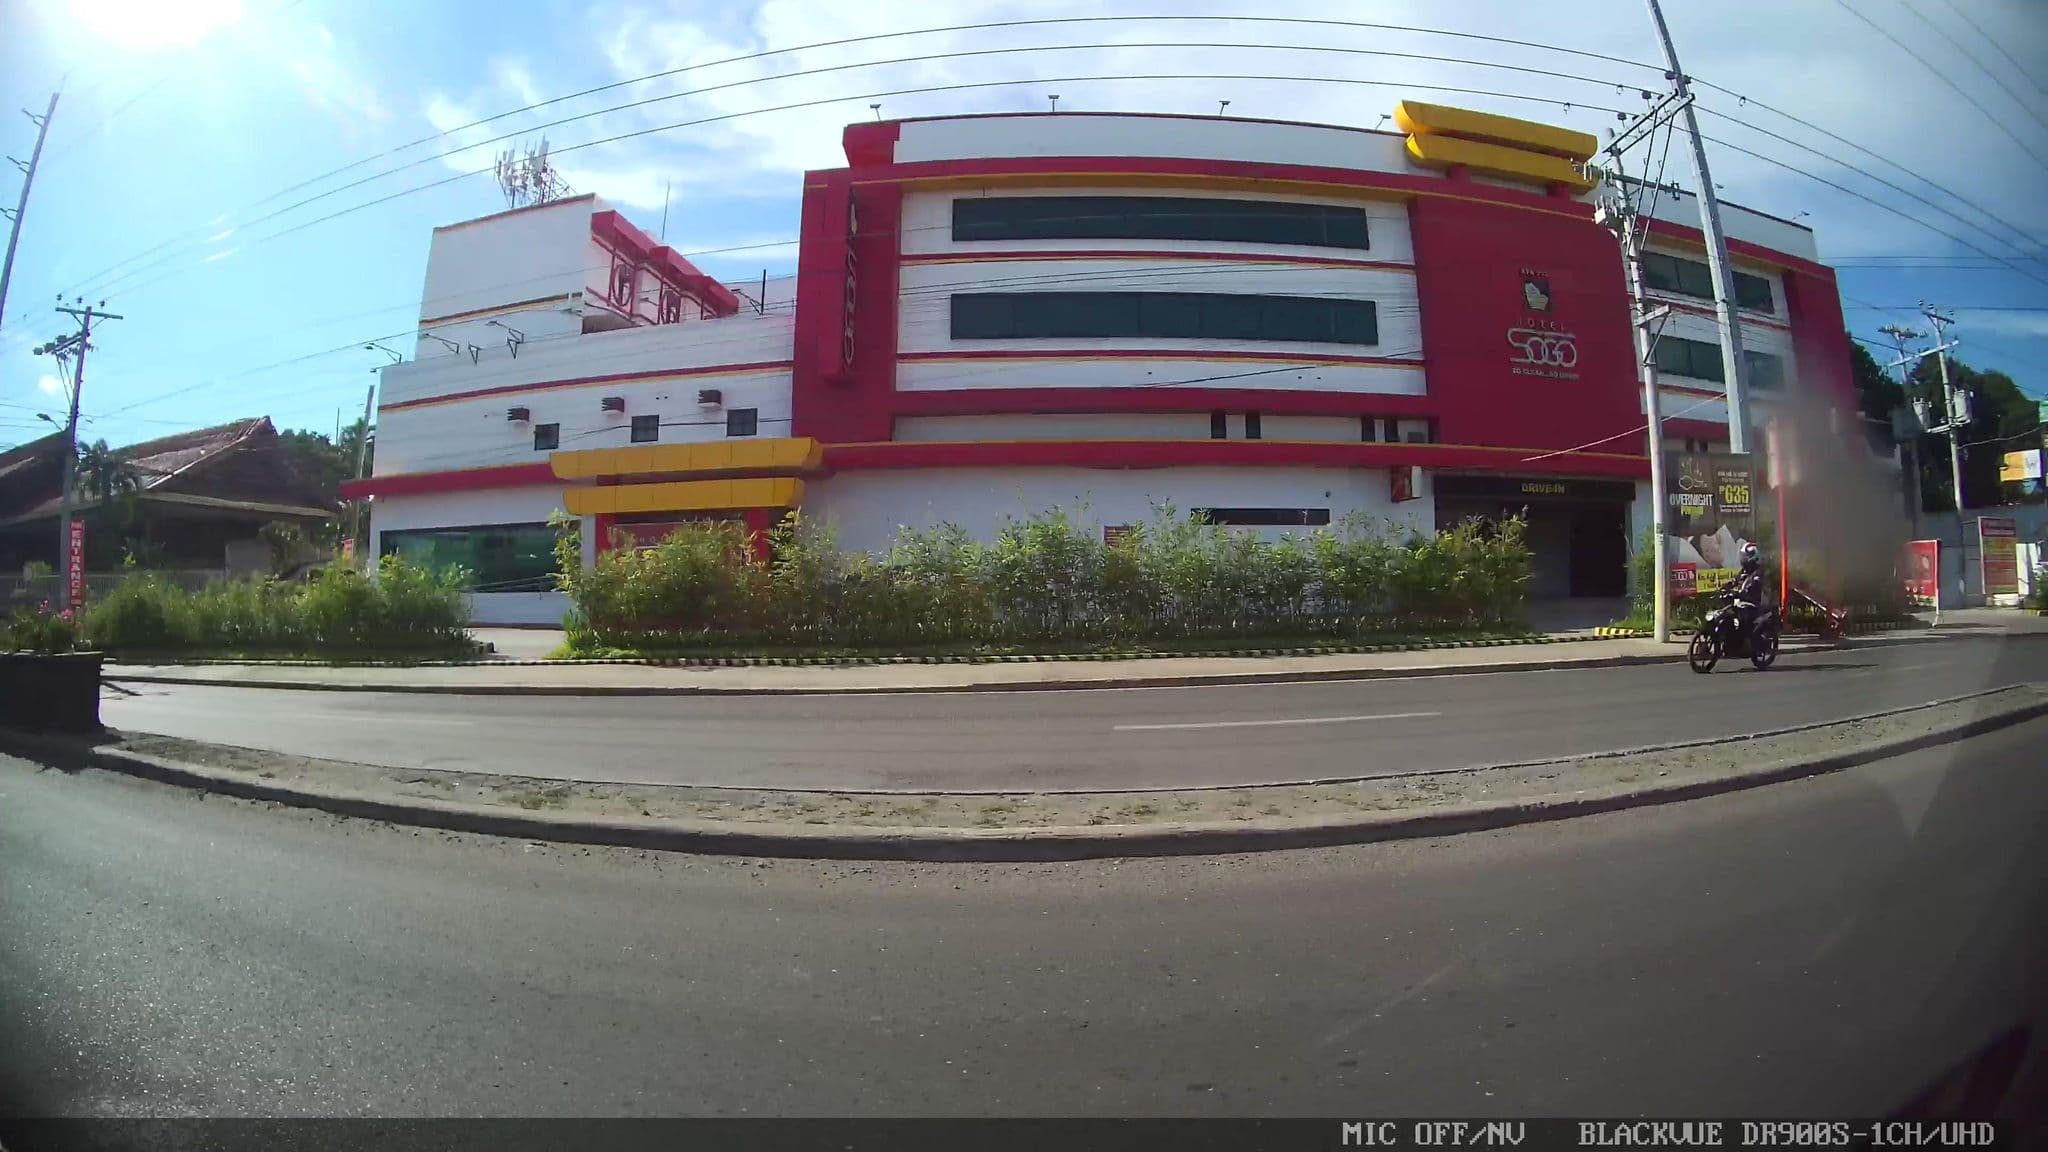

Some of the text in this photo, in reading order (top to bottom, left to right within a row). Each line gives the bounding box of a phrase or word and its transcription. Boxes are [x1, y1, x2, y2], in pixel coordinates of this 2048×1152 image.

[1507, 327, 1577, 368] SOGO
[1520, 482, 1566, 495] DRIVE-IN
[1669, 493, 1714, 507] OVERNIGHT
[70, 530, 82, 596] ENTRANCE
